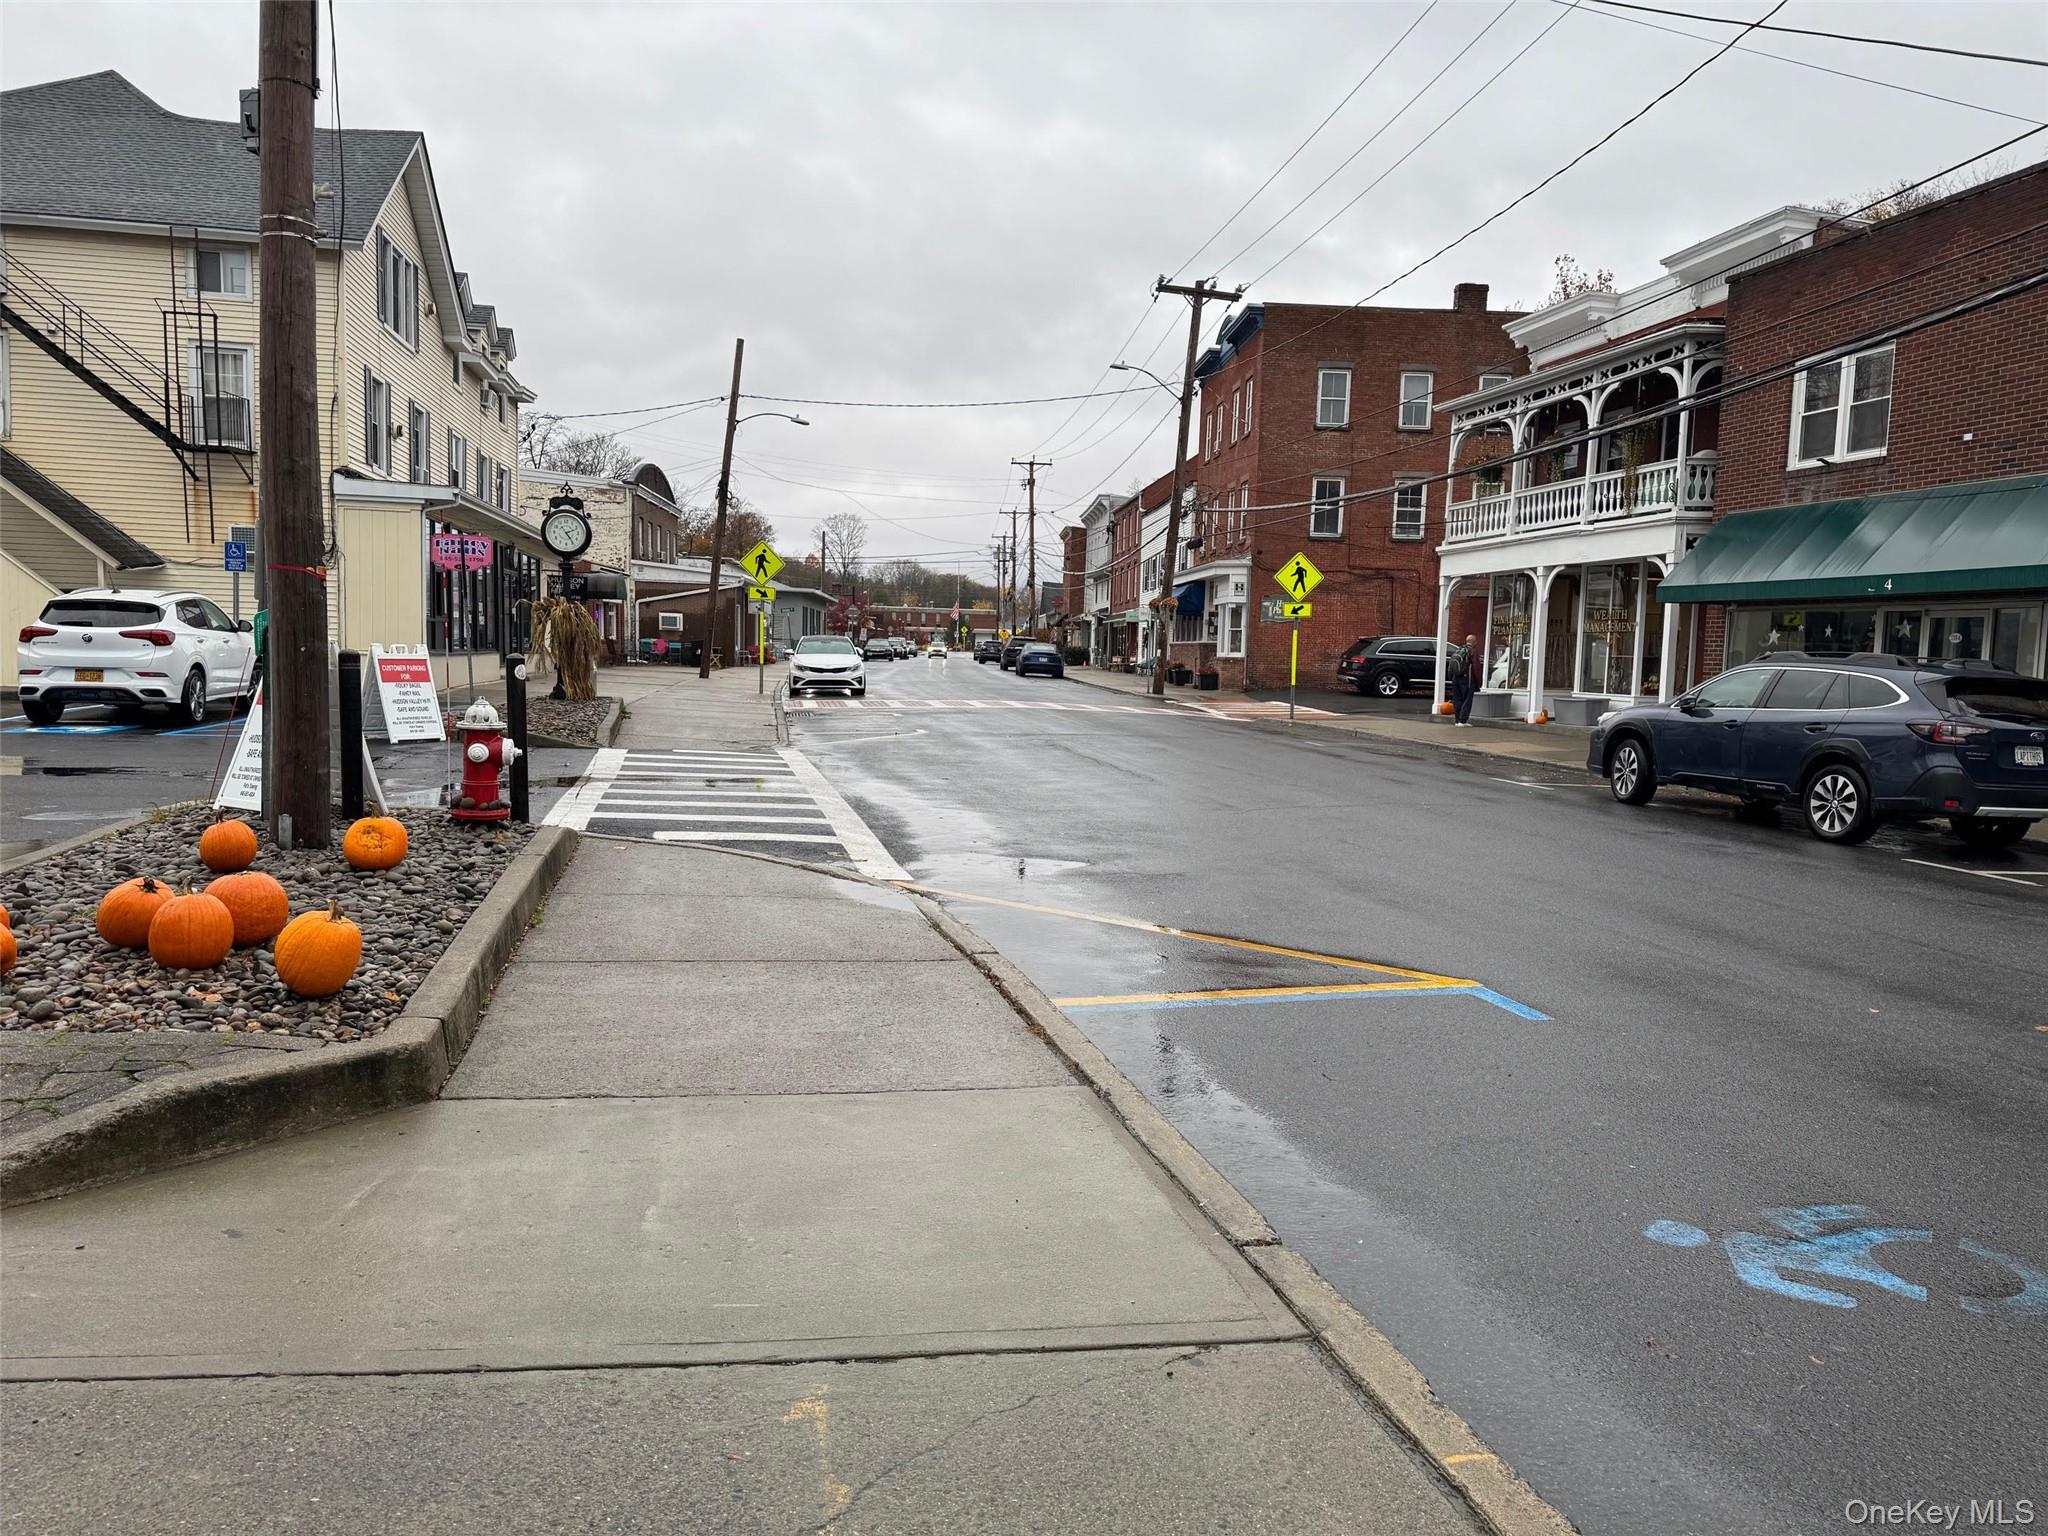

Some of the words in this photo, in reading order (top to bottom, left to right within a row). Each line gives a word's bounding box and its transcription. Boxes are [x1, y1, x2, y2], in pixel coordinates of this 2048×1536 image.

[1884, 577, 1893, 591] 4
[1494, 614, 1530, 625] FINANCIAL
[1593, 609, 1628, 620] WEALTH
[1493, 625, 1528, 635] PLANNING
[1584, 621, 1637, 633] MANAGEMENT
